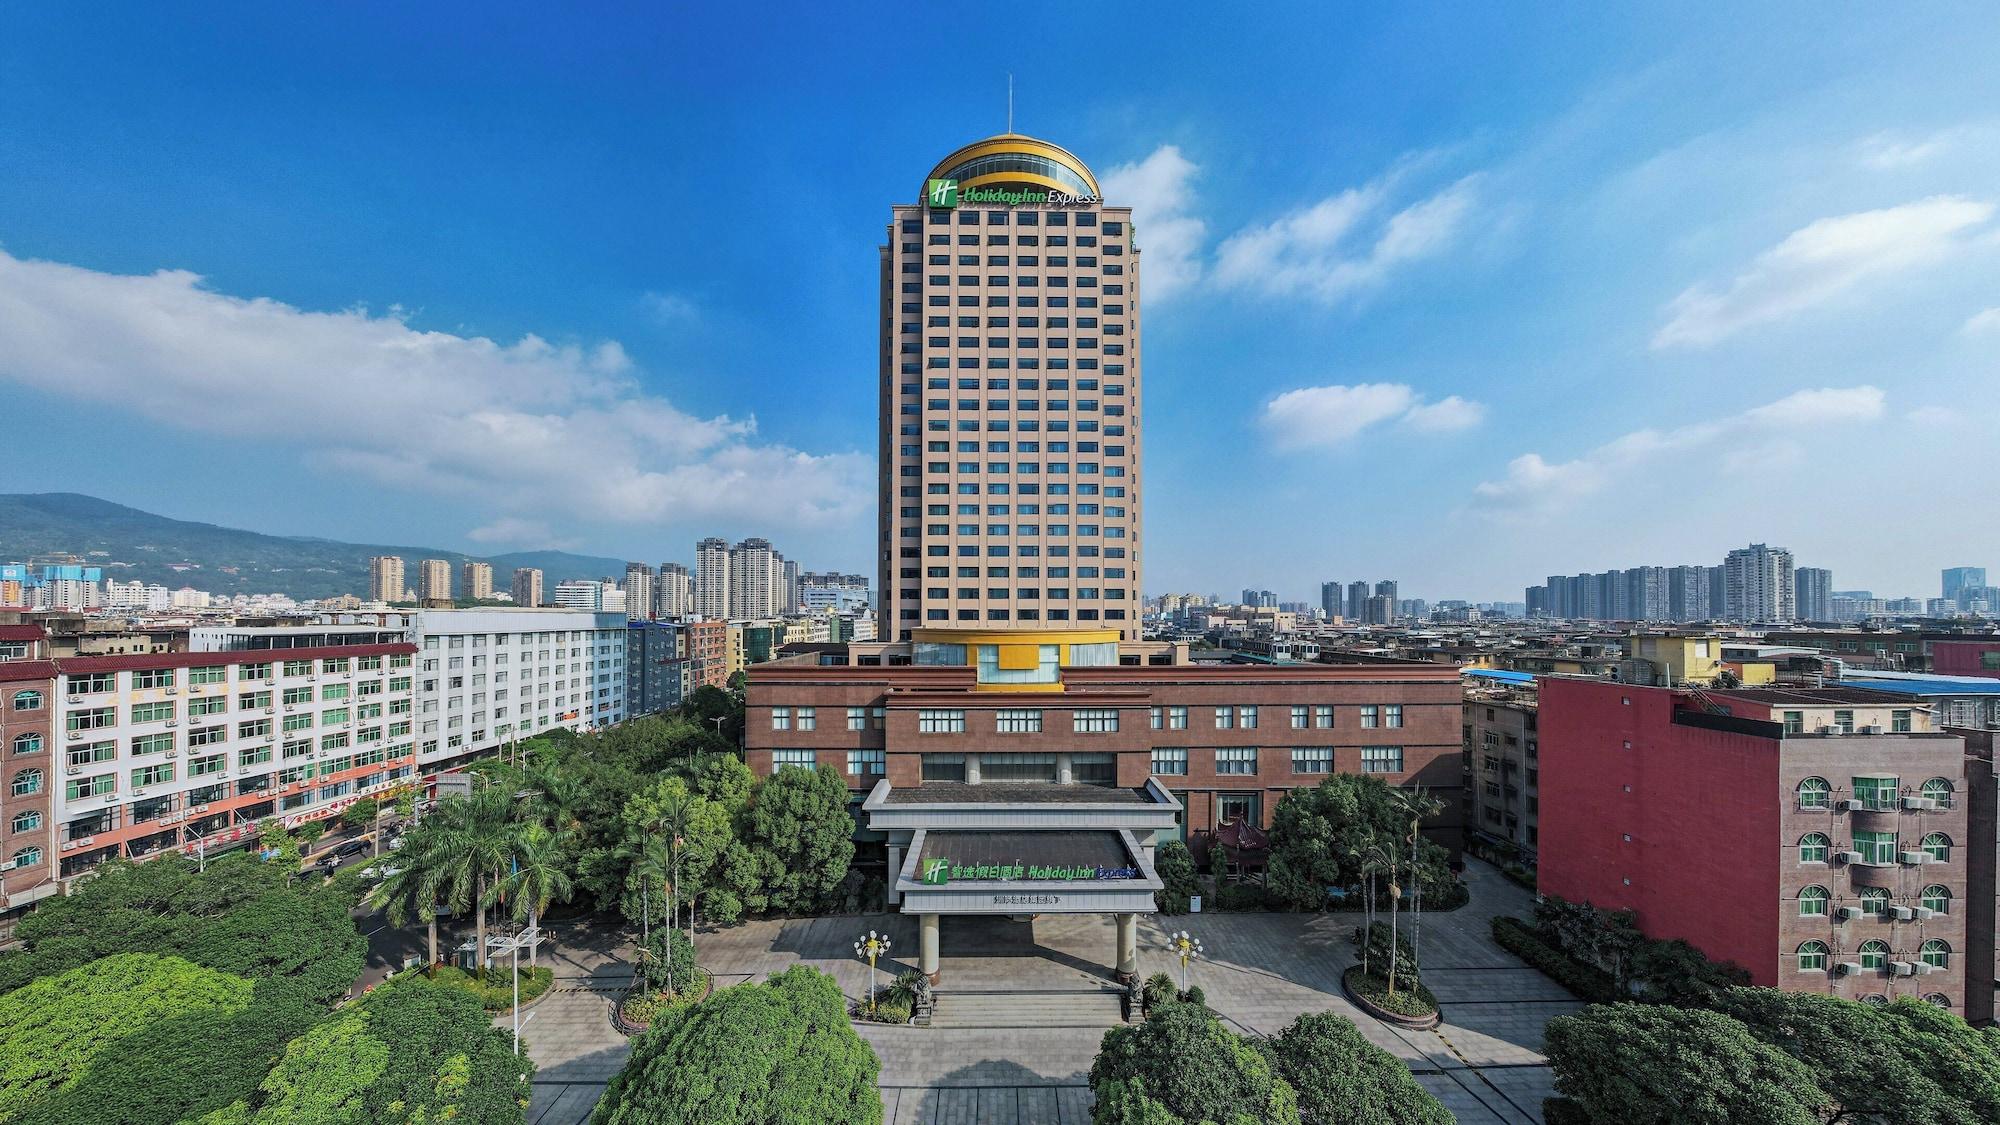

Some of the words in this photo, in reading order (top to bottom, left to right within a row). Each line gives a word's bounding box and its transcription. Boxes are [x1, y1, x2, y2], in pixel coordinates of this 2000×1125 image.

[963, 187, 1020, 206] Holiday
[1022, 188, 1046, 203] Inn
[1047, 190, 1097, 206] Express
[952, 865, 1024, 879] 智选假日酒店
[1028, 865, 1074, 880] Holiday
[1075, 865, 1095, 878] Inn
